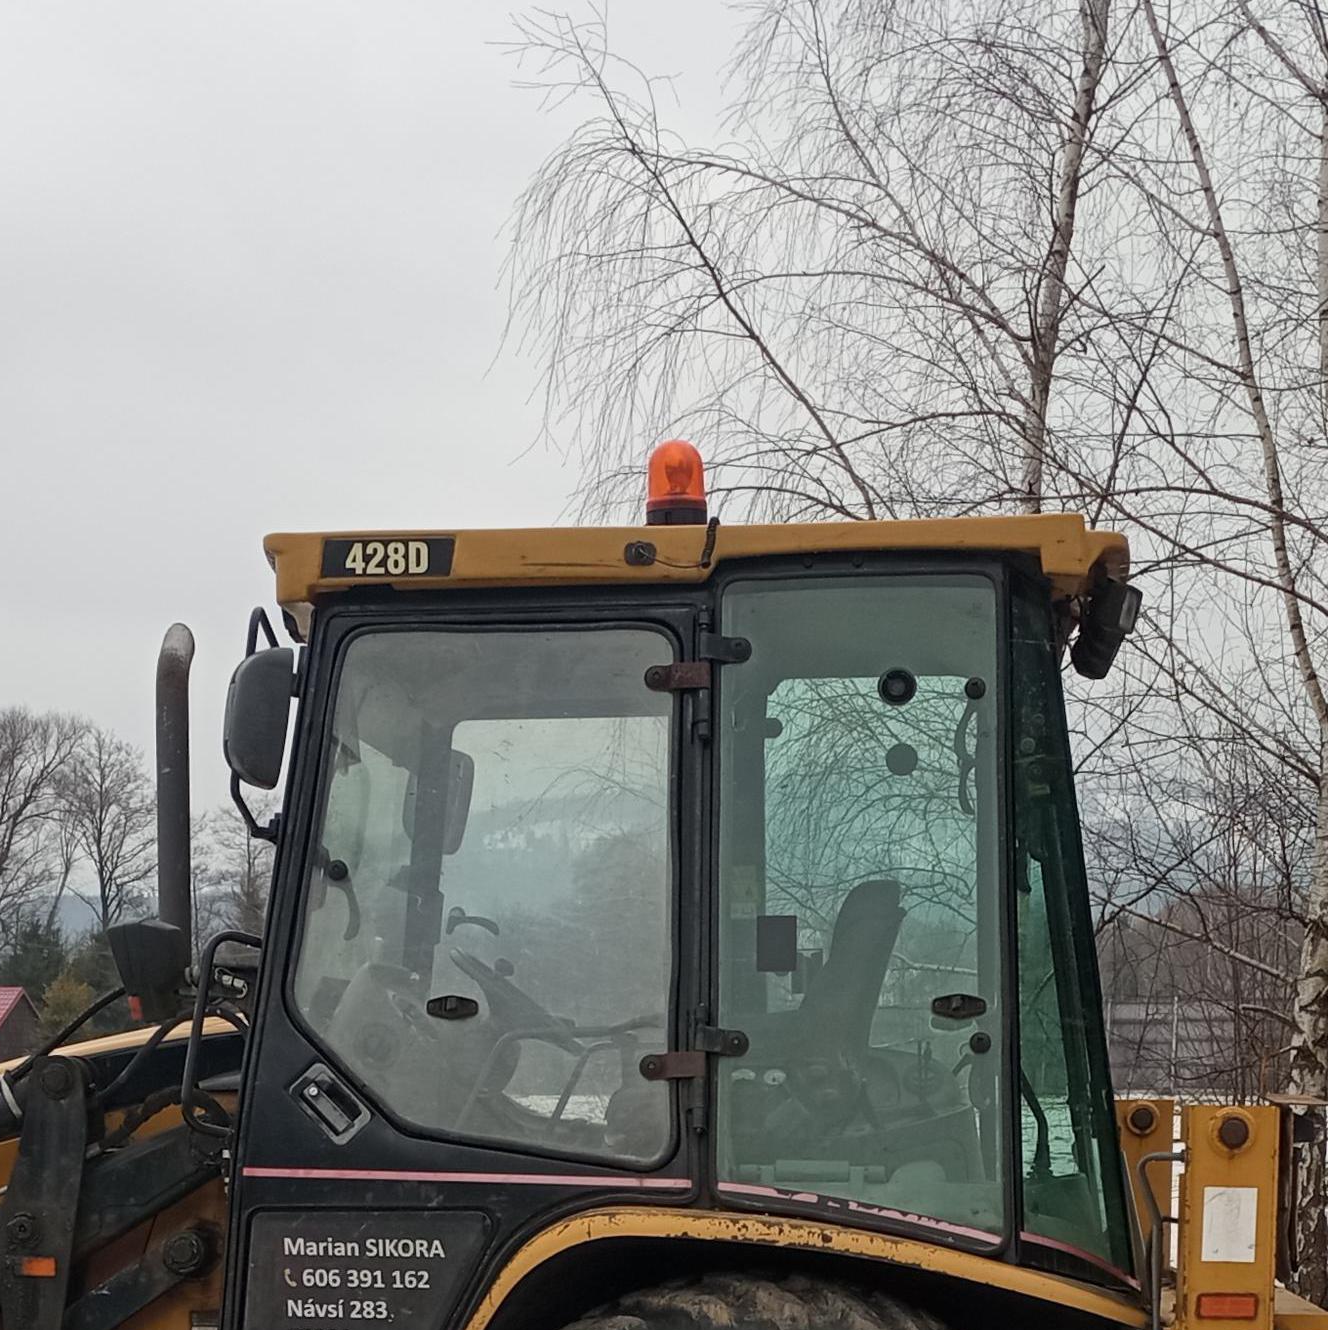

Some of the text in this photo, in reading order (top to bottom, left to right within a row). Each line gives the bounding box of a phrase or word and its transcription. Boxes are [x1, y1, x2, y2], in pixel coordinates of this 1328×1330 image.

[345, 541, 429, 575] 428D
[283, 1237, 445, 1258] Marian SIKORA
[302, 1268, 430, 1288] 606 391 162
[287, 1298, 344, 1318] Návsí
